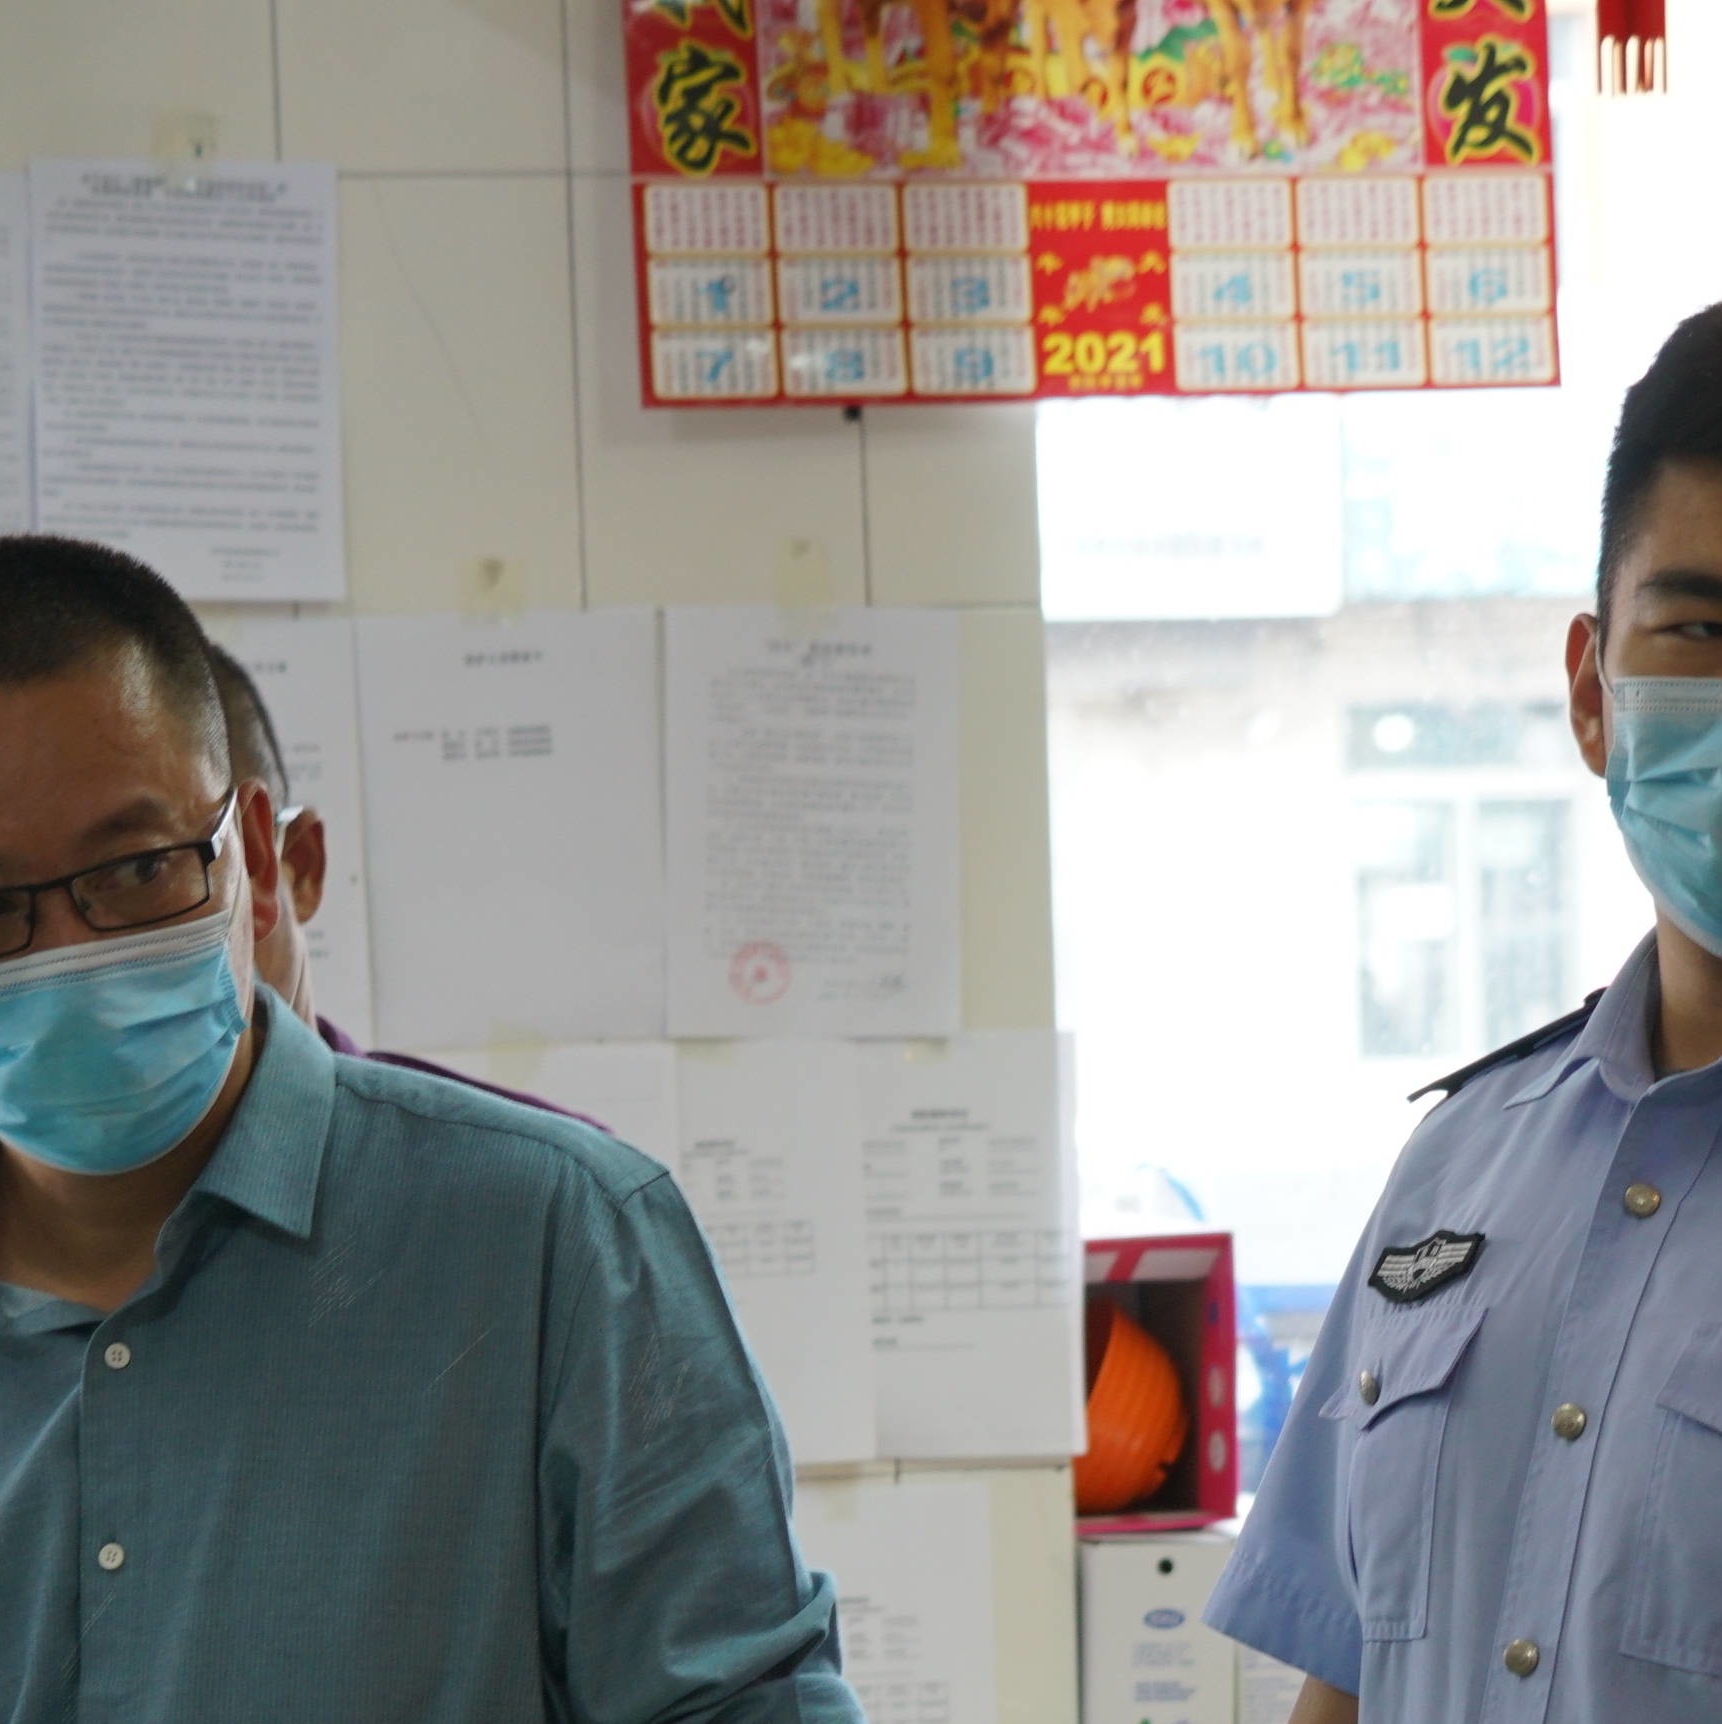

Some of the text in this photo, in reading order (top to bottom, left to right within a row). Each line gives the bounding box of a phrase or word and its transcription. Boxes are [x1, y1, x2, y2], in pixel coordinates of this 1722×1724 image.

[657, 42, 753, 172] 家
[1444, 38, 1535, 162] 发
[820, 278, 859, 311] 2
[952, 276, 990, 312] 3
[1213, 273, 1252, 304] 4
[1341, 269, 1381, 303] 5
[1468, 267, 1508, 303] 6
[697, 349, 733, 383] 7
[826, 349, 864, 382] 8
[955, 347, 994, 381] 9
[1042, 330, 1165, 375] 2021
[1199, 342, 1278, 377] 10
[1331, 339, 1401, 372] 11
[1453, 336, 1530, 371] 12
